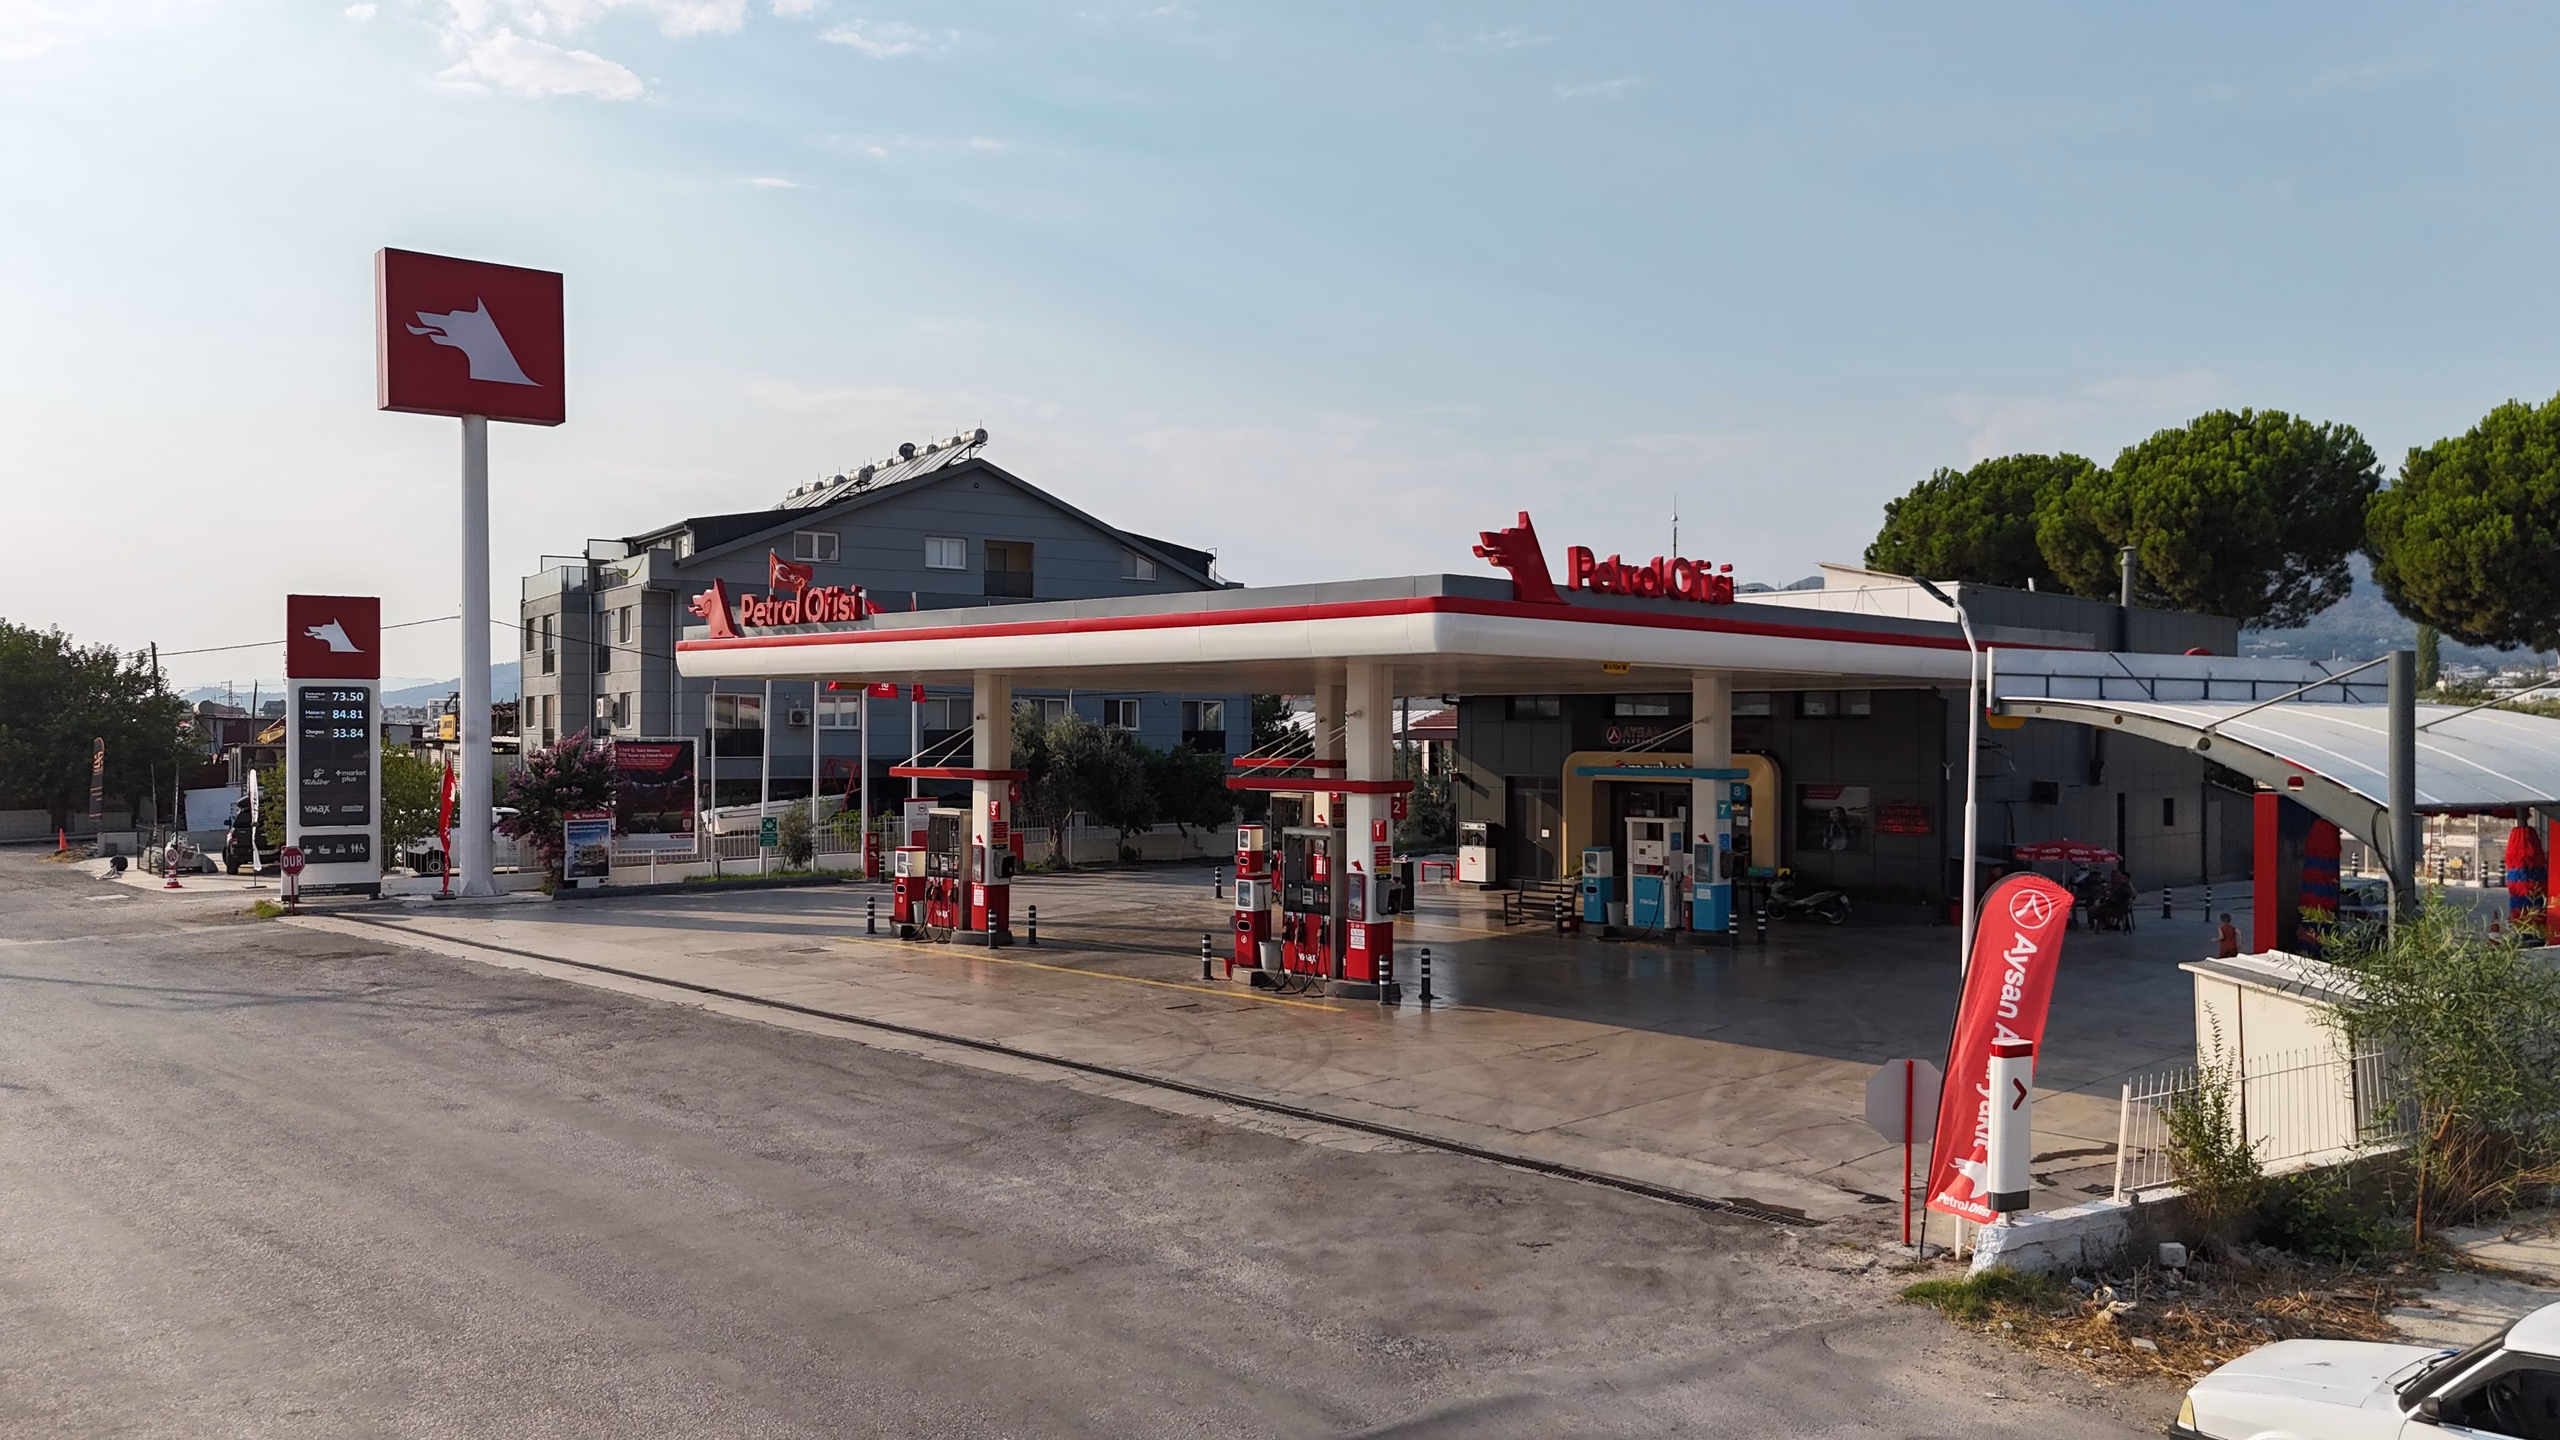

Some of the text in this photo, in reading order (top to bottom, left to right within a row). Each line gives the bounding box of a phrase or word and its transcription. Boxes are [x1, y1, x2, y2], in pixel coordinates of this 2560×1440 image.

[1567, 546, 1734, 605] Petrol Ofisi
[741, 584, 861, 626] Petrol Ofisi
[332, 692, 364, 701] 73.50
[332, 709, 364, 719] 84.81
[332, 728, 364, 738] 33.84
[342, 776, 357, 784] plus
[1010, 786, 1016, 796] 4
[1733, 786, 1741, 796] 8
[990, 805, 996, 816] 3
[1393, 801, 1401, 814] 2
[1720, 804, 1727, 815] 7
[1375, 823, 1380, 836] 1
[283, 855, 303, 868] DUR
[1997, 931, 2038, 1019] Aysan
[1936, 1191, 1992, 1218] Petrol Ofisi
